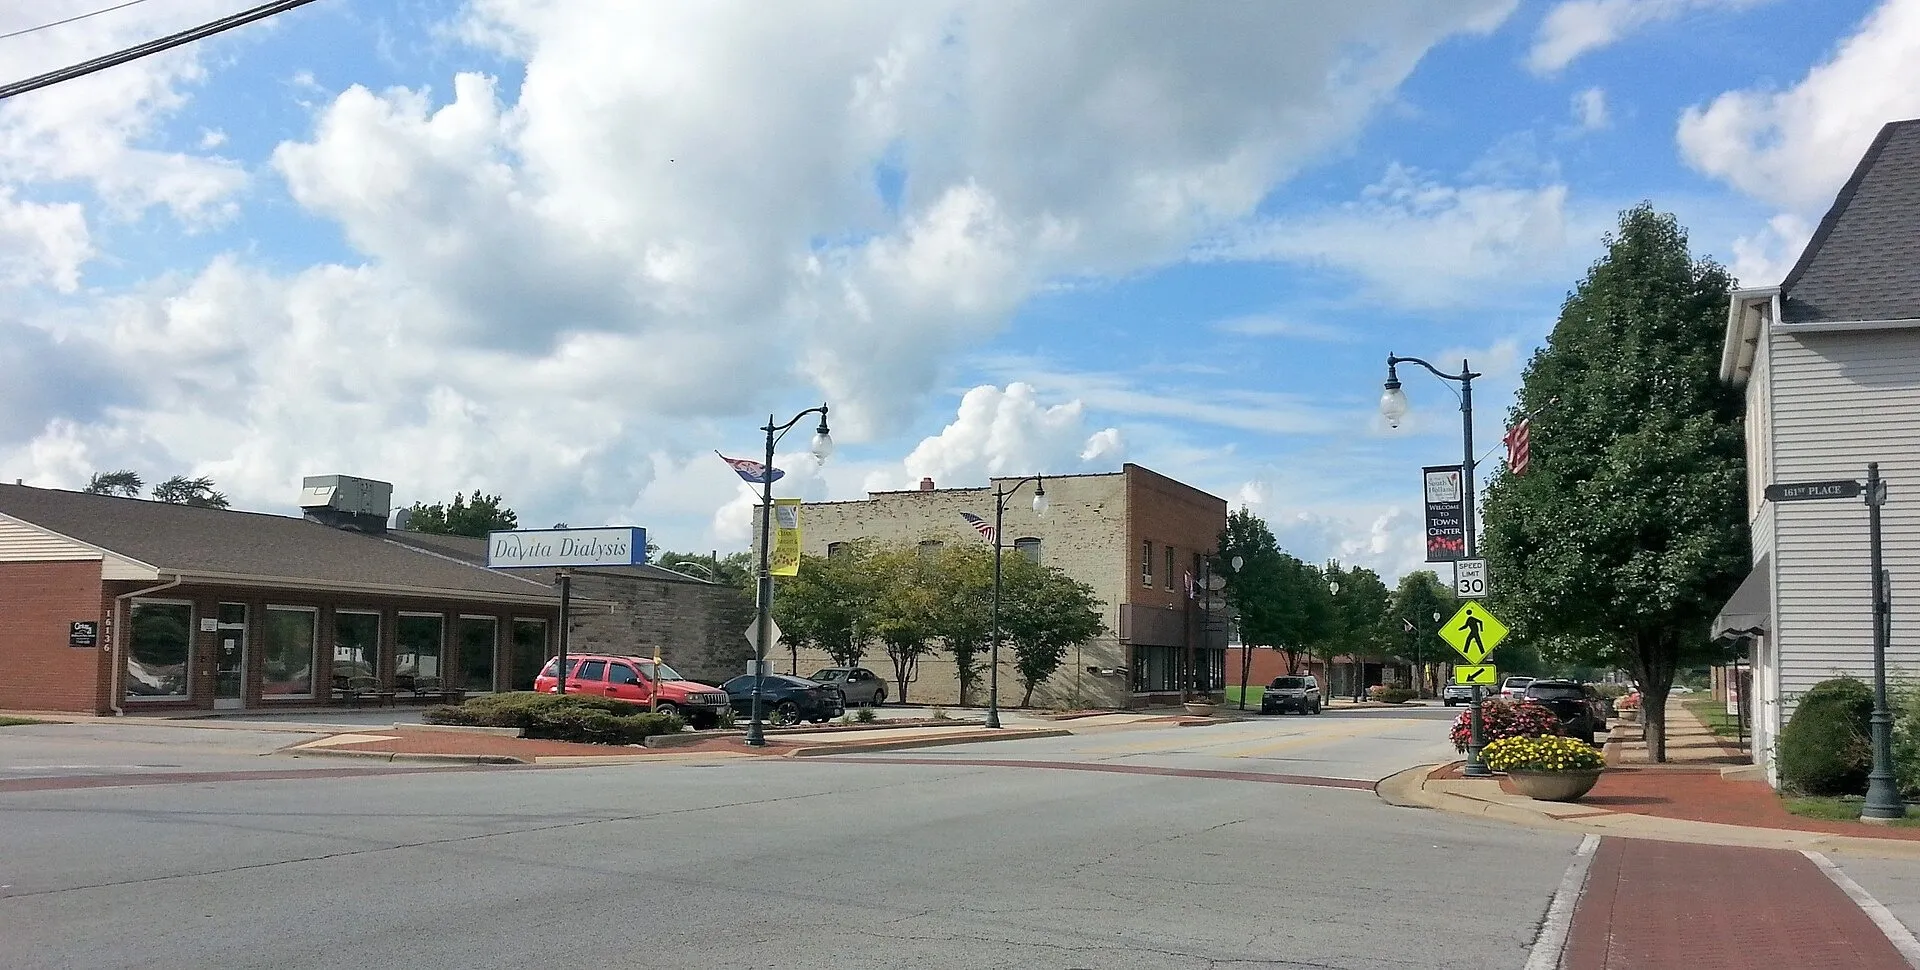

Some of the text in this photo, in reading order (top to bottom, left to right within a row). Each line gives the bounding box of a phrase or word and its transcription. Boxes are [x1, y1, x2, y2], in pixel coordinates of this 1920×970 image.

[1808, 485, 1842, 496] PLACE
[1431, 518, 1459, 526] TOWN
[1428, 528, 1462, 536] CENTER
[494, 533, 627, 562] DaVita Dialysis
[1458, 562, 1482, 570] SPEED
[1459, 578, 1484, 594] 30
[103, 609, 112, 652] 16136
